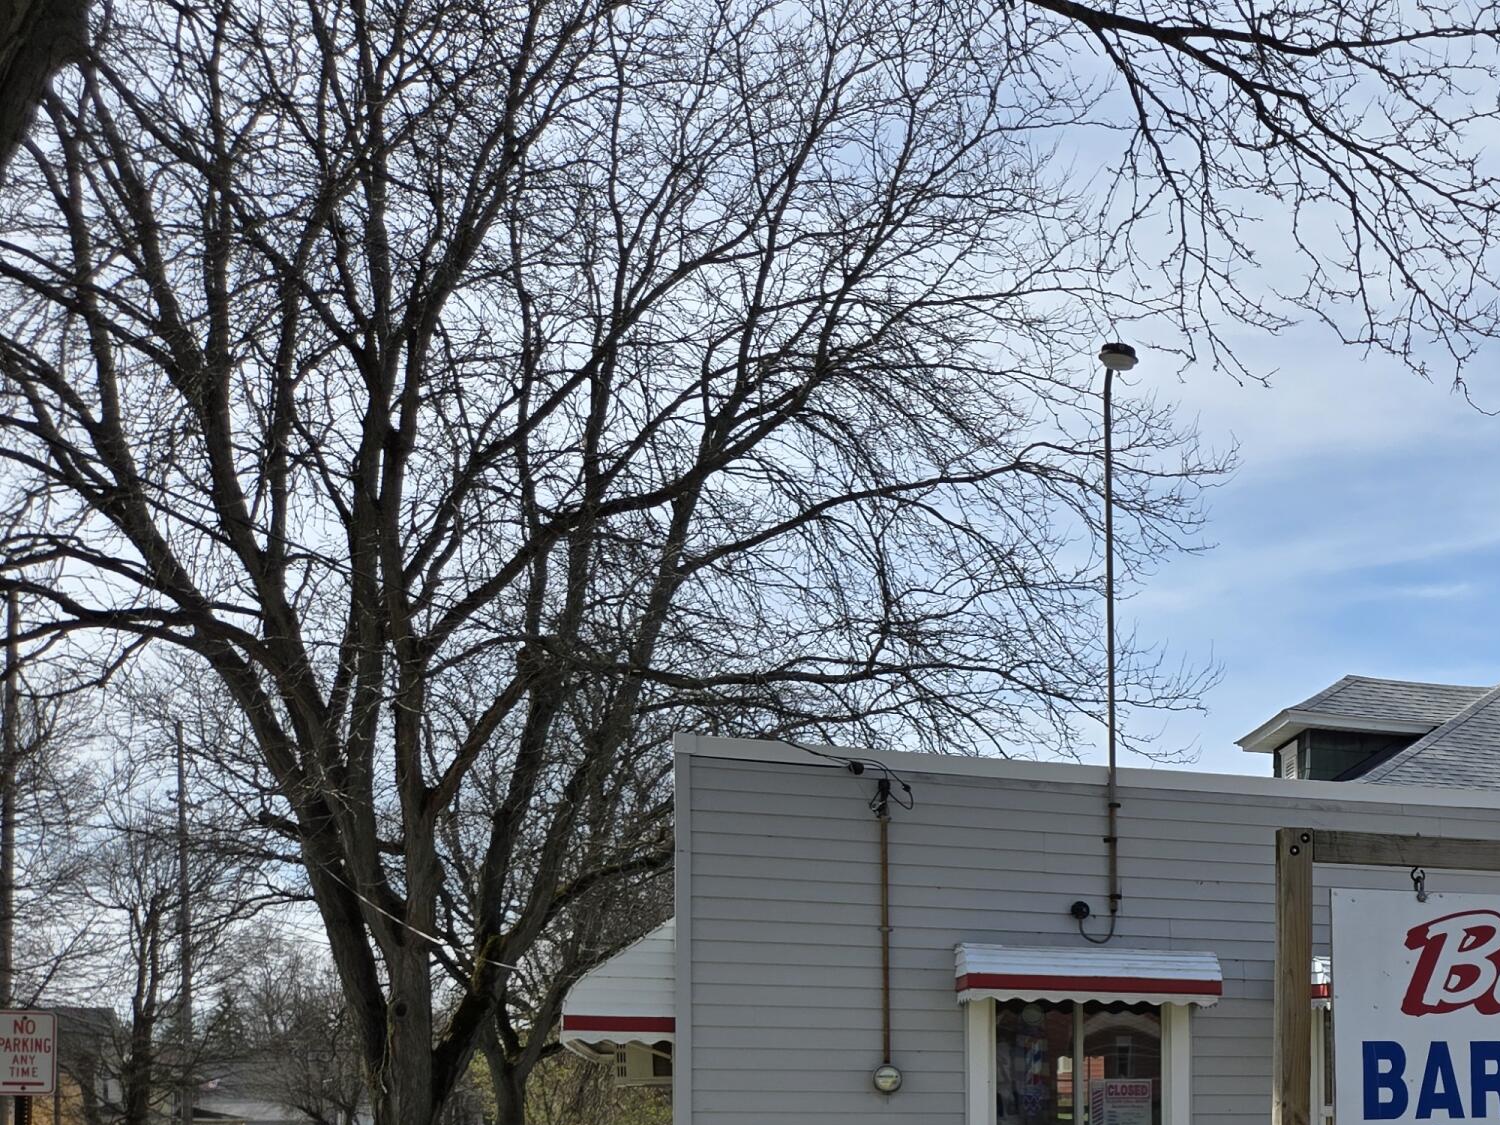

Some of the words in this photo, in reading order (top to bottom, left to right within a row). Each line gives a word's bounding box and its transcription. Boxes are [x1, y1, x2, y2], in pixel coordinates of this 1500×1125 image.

[13, 1019, 36, 1035] NO
[0, 1037, 51, 1053] PARKING
[12, 1054, 36, 1065] ANY
[9, 1066, 38, 1078] TIME
[1107, 1084, 1149, 1096] CLOSED
